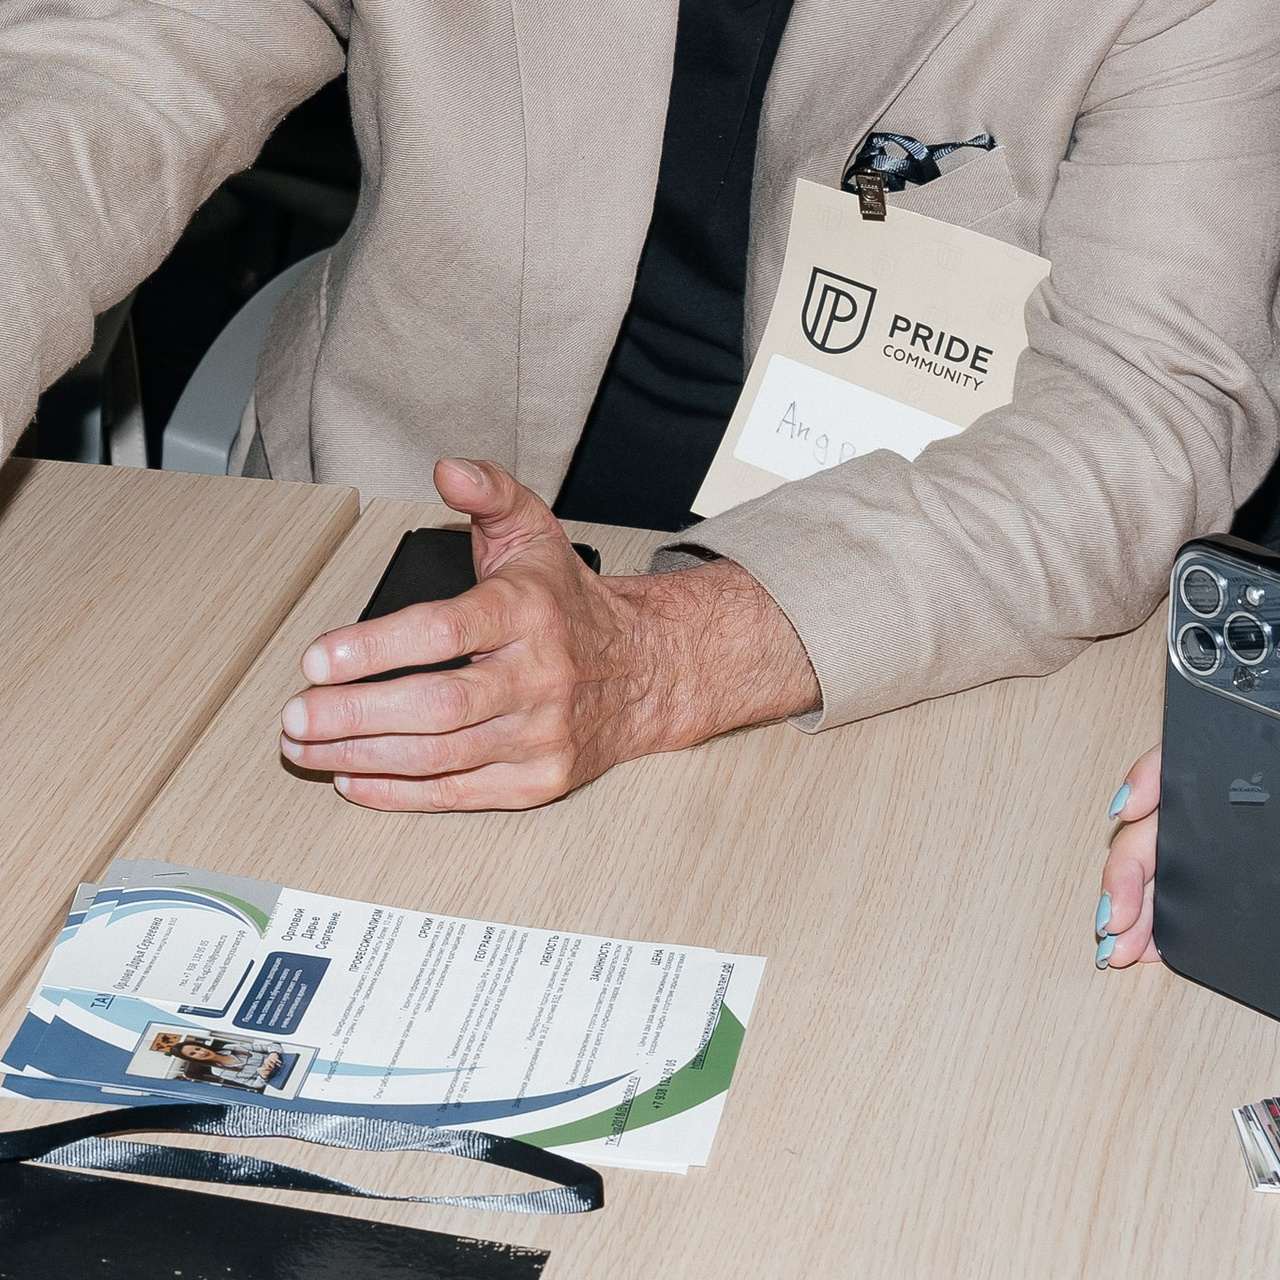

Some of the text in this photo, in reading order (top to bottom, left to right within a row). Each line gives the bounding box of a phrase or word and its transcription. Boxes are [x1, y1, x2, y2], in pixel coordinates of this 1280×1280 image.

[888, 314, 994, 375] PRIDE
[882, 344, 984, 391] COMMUNITY
[280, 907, 305, 941] Орловой
[300, 915, 321, 939] Дарье
[315, 909, 342, 950] Сергеевне.
[348, 908, 383, 972] ПРОФЕССИОНАЛИЗМ
[417, 917, 434, 938] СРОКИ
[473, 925, 495, 962] ГЕОГРАФИЯ
[539, 934, 559, 966] ГИБКОСТЬ
[589, 940, 611, 981] ЗАКОННОСТЬ
[649, 948, 665, 965] ЦЕНА
